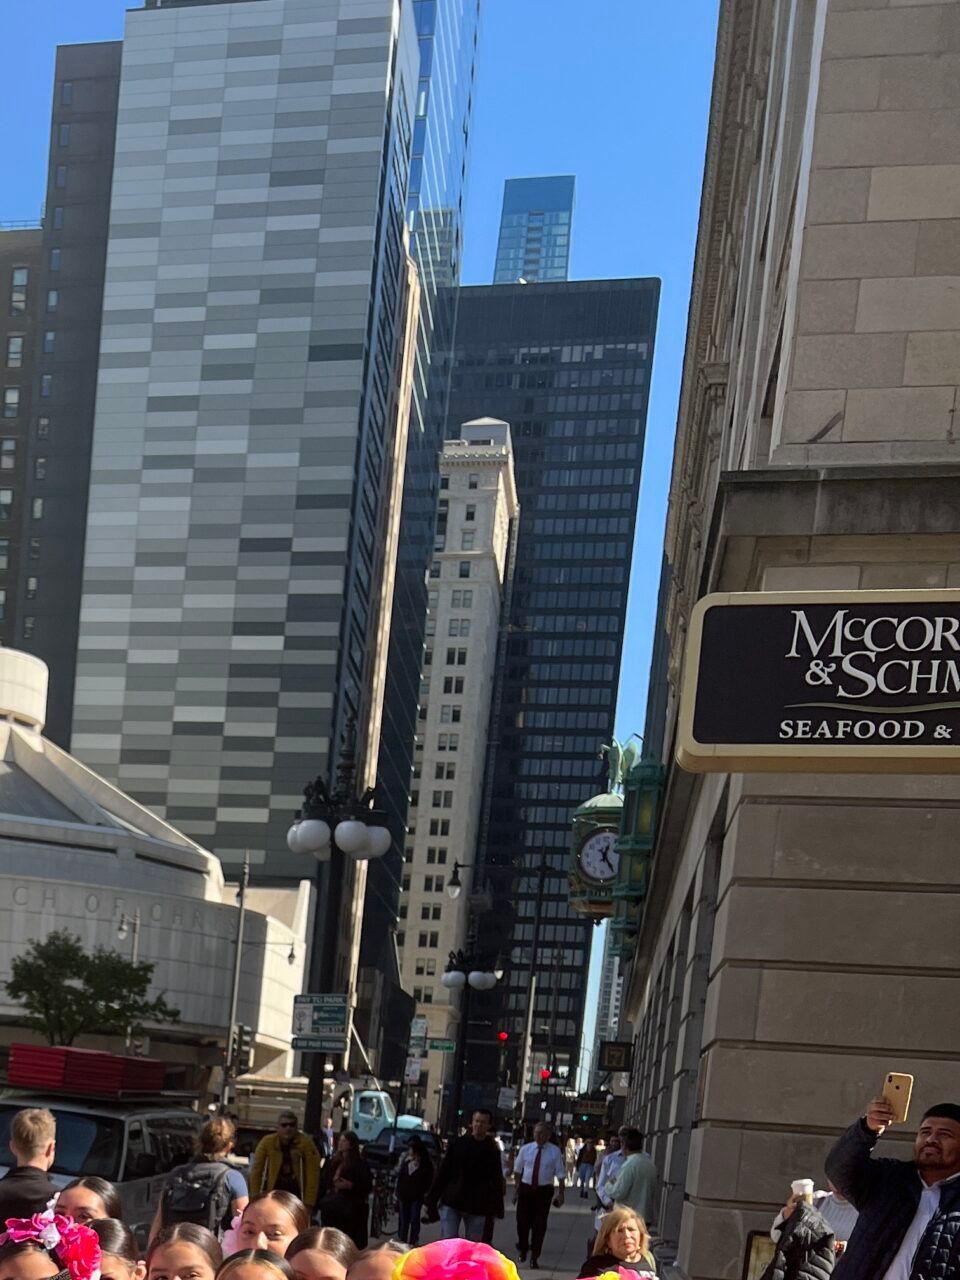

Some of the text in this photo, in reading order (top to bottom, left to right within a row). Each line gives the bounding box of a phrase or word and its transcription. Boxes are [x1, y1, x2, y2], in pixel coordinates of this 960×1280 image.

[805, 659, 836, 686] &
[779, 719, 953, 740] SEAFOOD &
